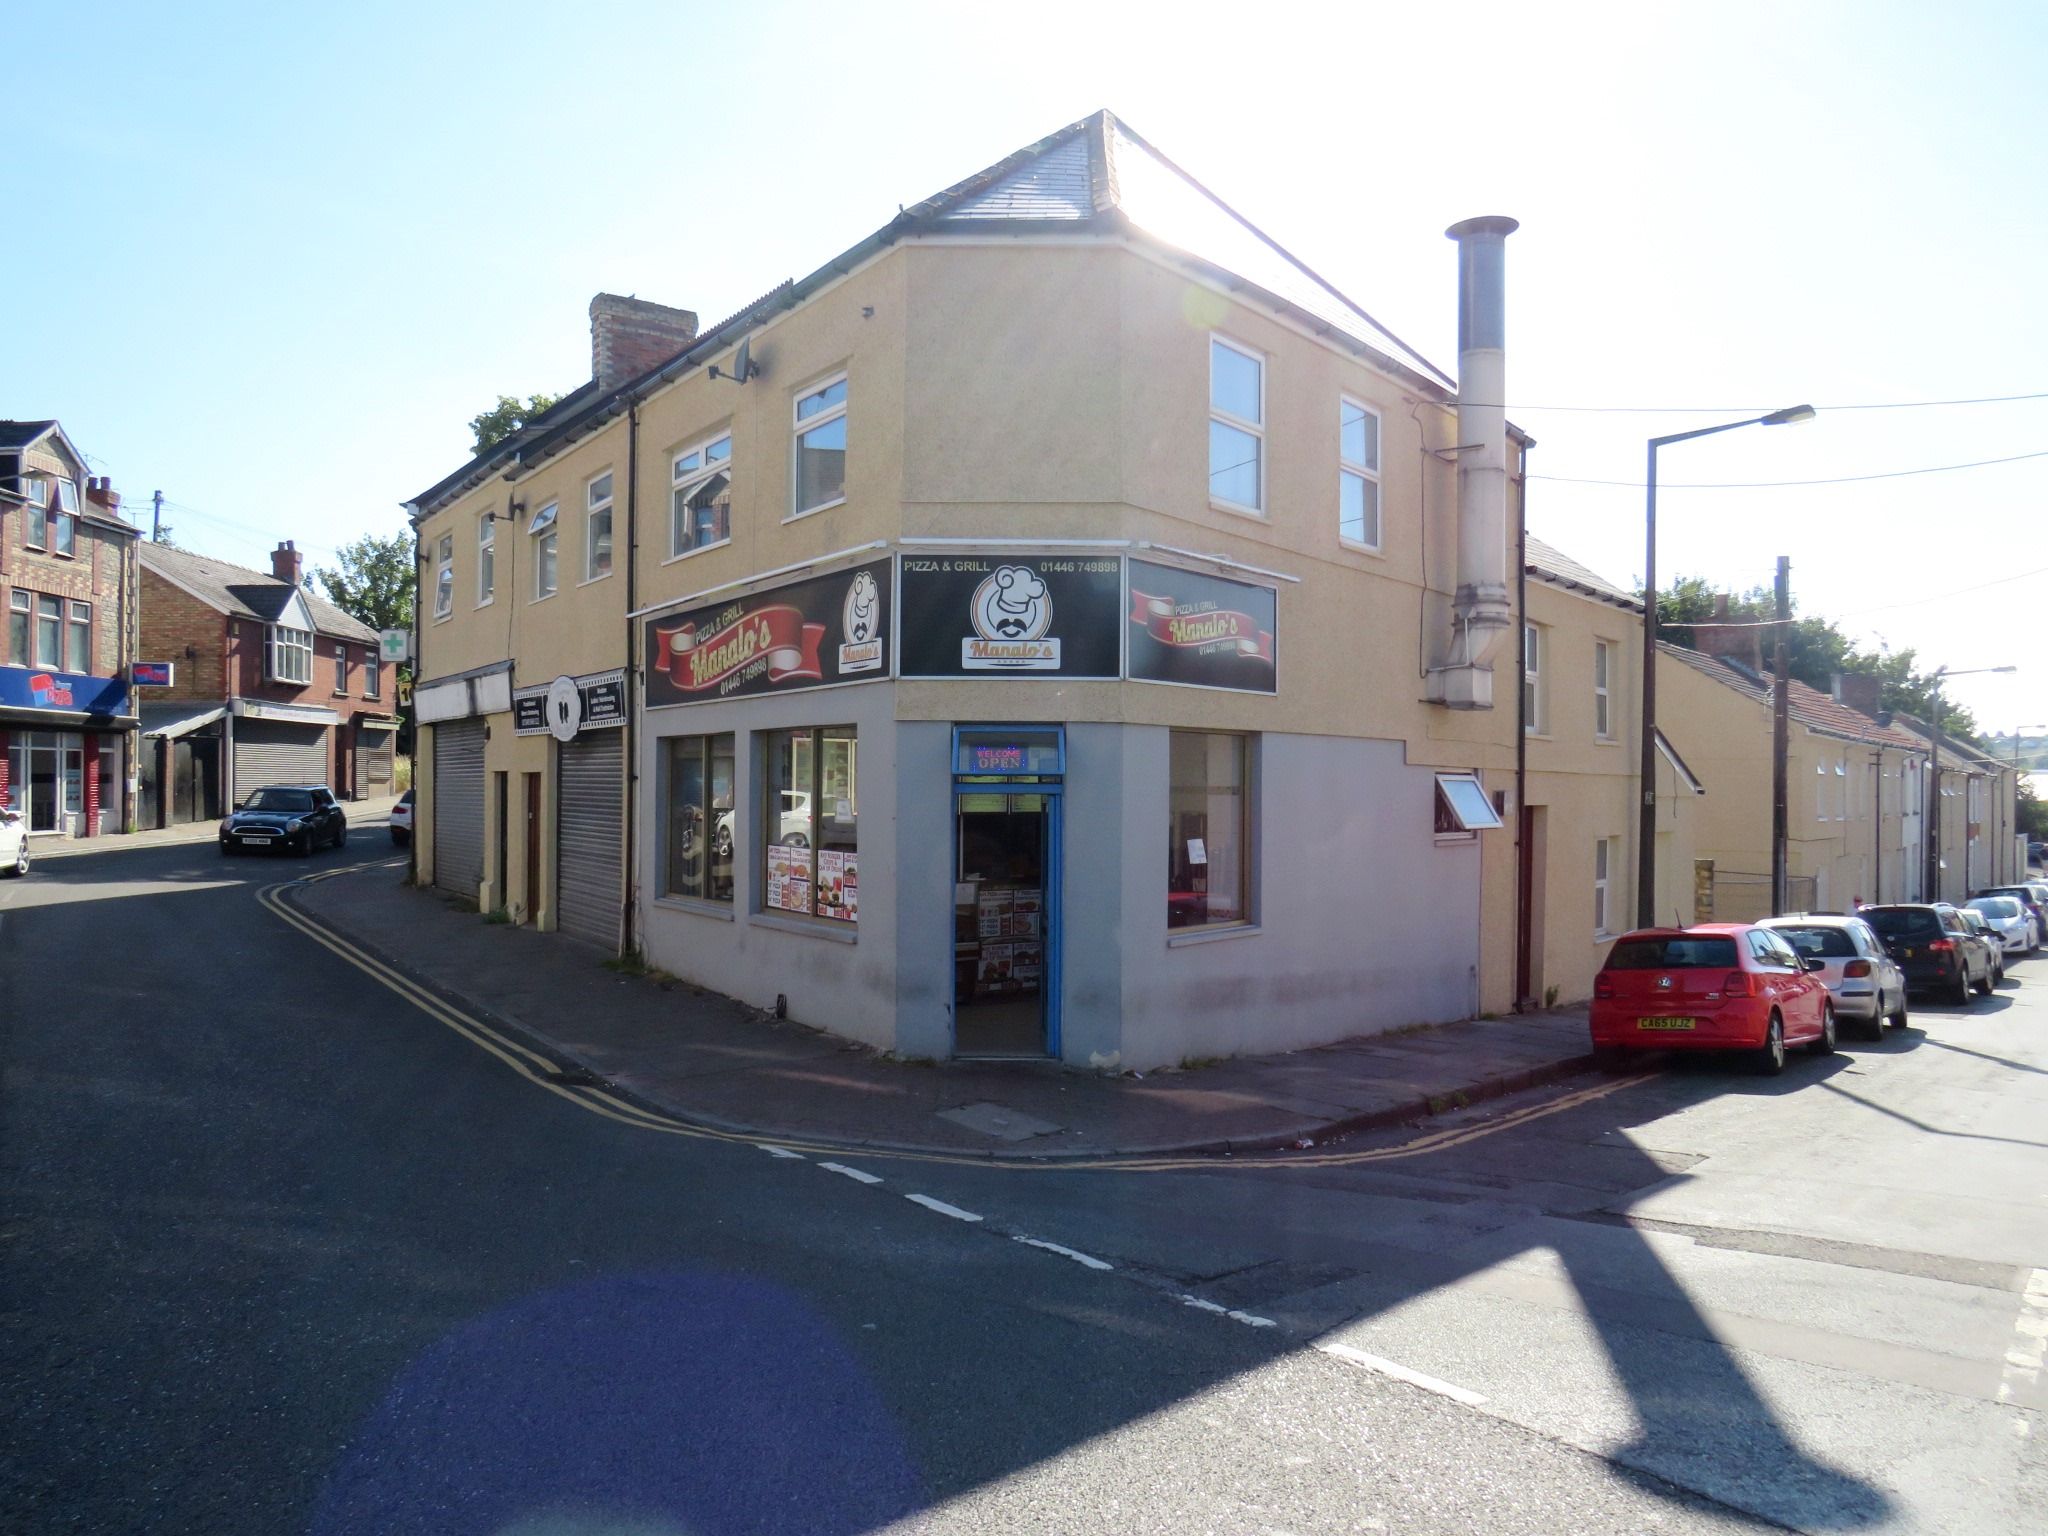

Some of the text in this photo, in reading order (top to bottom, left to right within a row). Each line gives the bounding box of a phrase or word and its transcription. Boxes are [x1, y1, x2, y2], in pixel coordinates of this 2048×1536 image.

[904, 561, 990, 572] PIZZA & GRILL
[1041, 562, 1117, 572] 01446 749898
[1175, 604, 1193, 615] PIZZA
[696, 622, 715, 645] PIZZA
[722, 602, 744, 625] GRILL
[720, 673, 741, 695] 01446
[977, 750, 1022, 758] WELCOME
[979, 757, 1021, 769] OPEN
[1641, 1019, 1668, 1027] CA65
